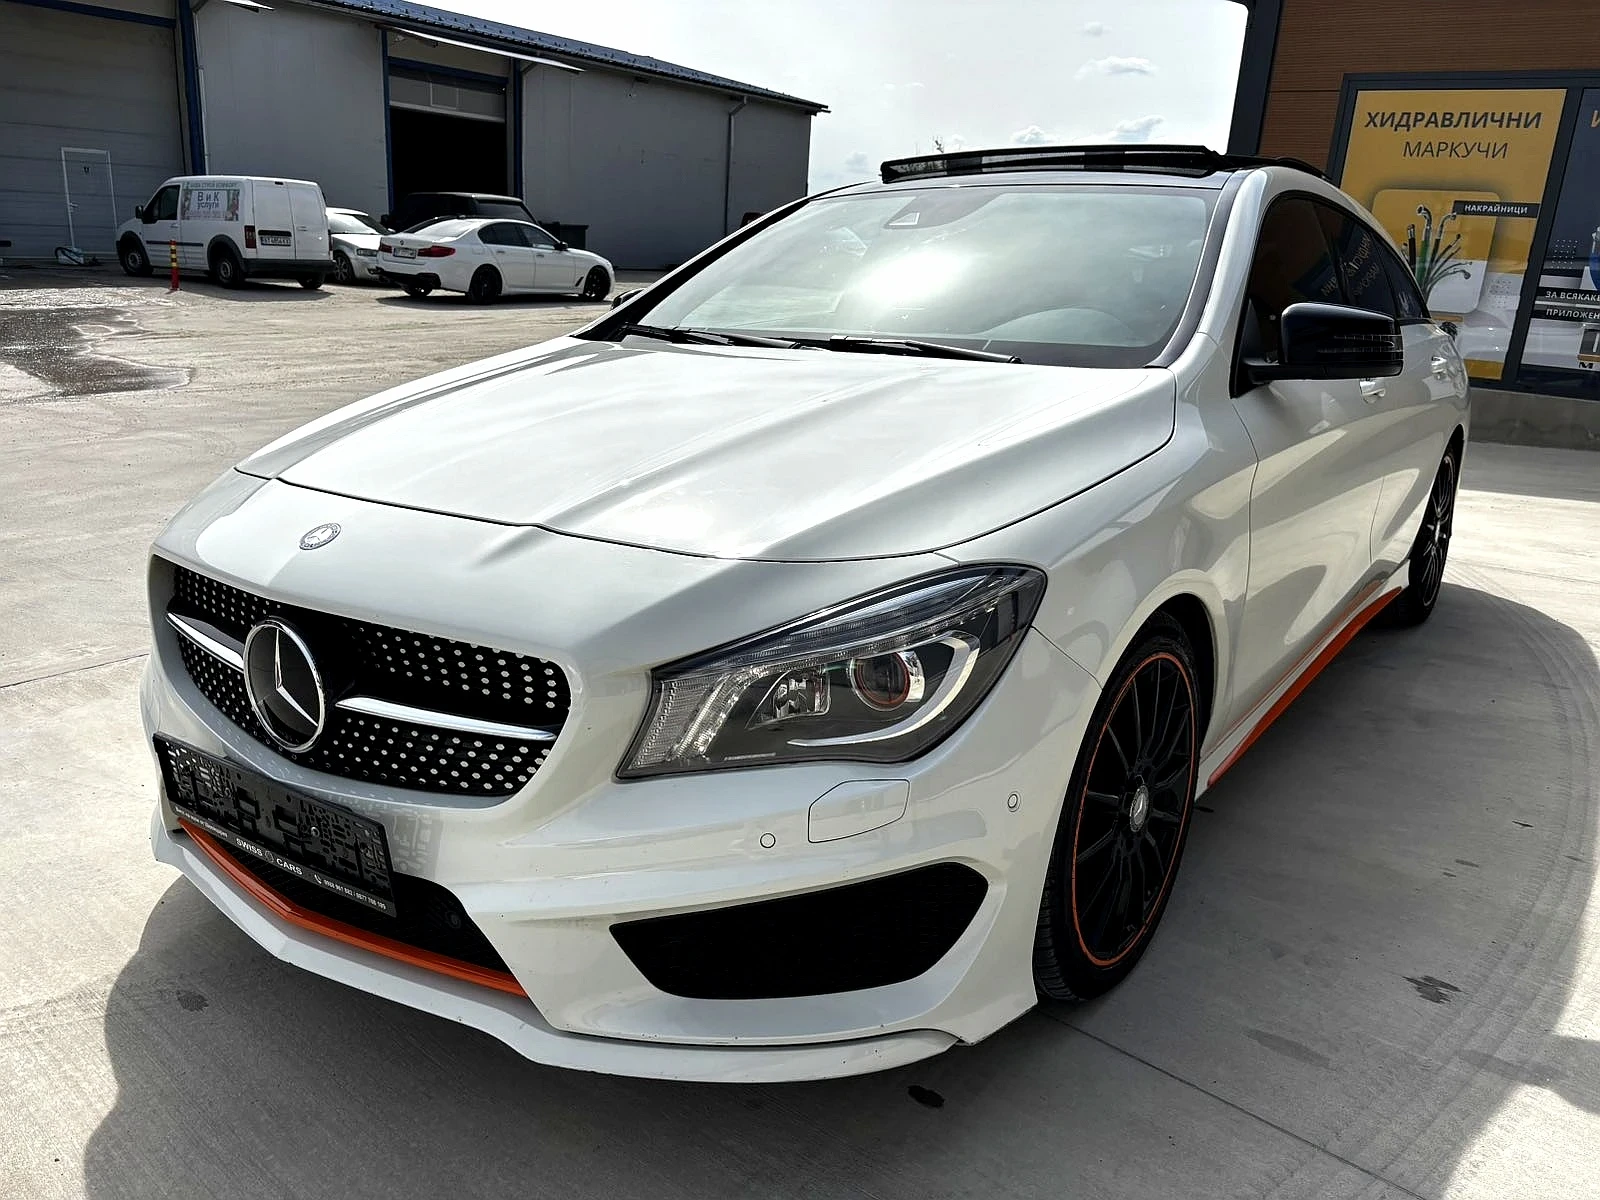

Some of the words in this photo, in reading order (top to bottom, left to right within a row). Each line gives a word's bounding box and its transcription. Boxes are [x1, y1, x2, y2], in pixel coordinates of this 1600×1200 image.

[1364, 111, 1542, 132] ХИДРАВЛИЧНИ
[1402, 141, 1509, 159] МАРКУЧИ
[1464, 204, 1528, 215] НАКРАЙНИЦИ
[1545, 290, 1557, 299] ЗА
[236, 837, 263, 857] SWISS
[276, 858, 303, 876] CARS
